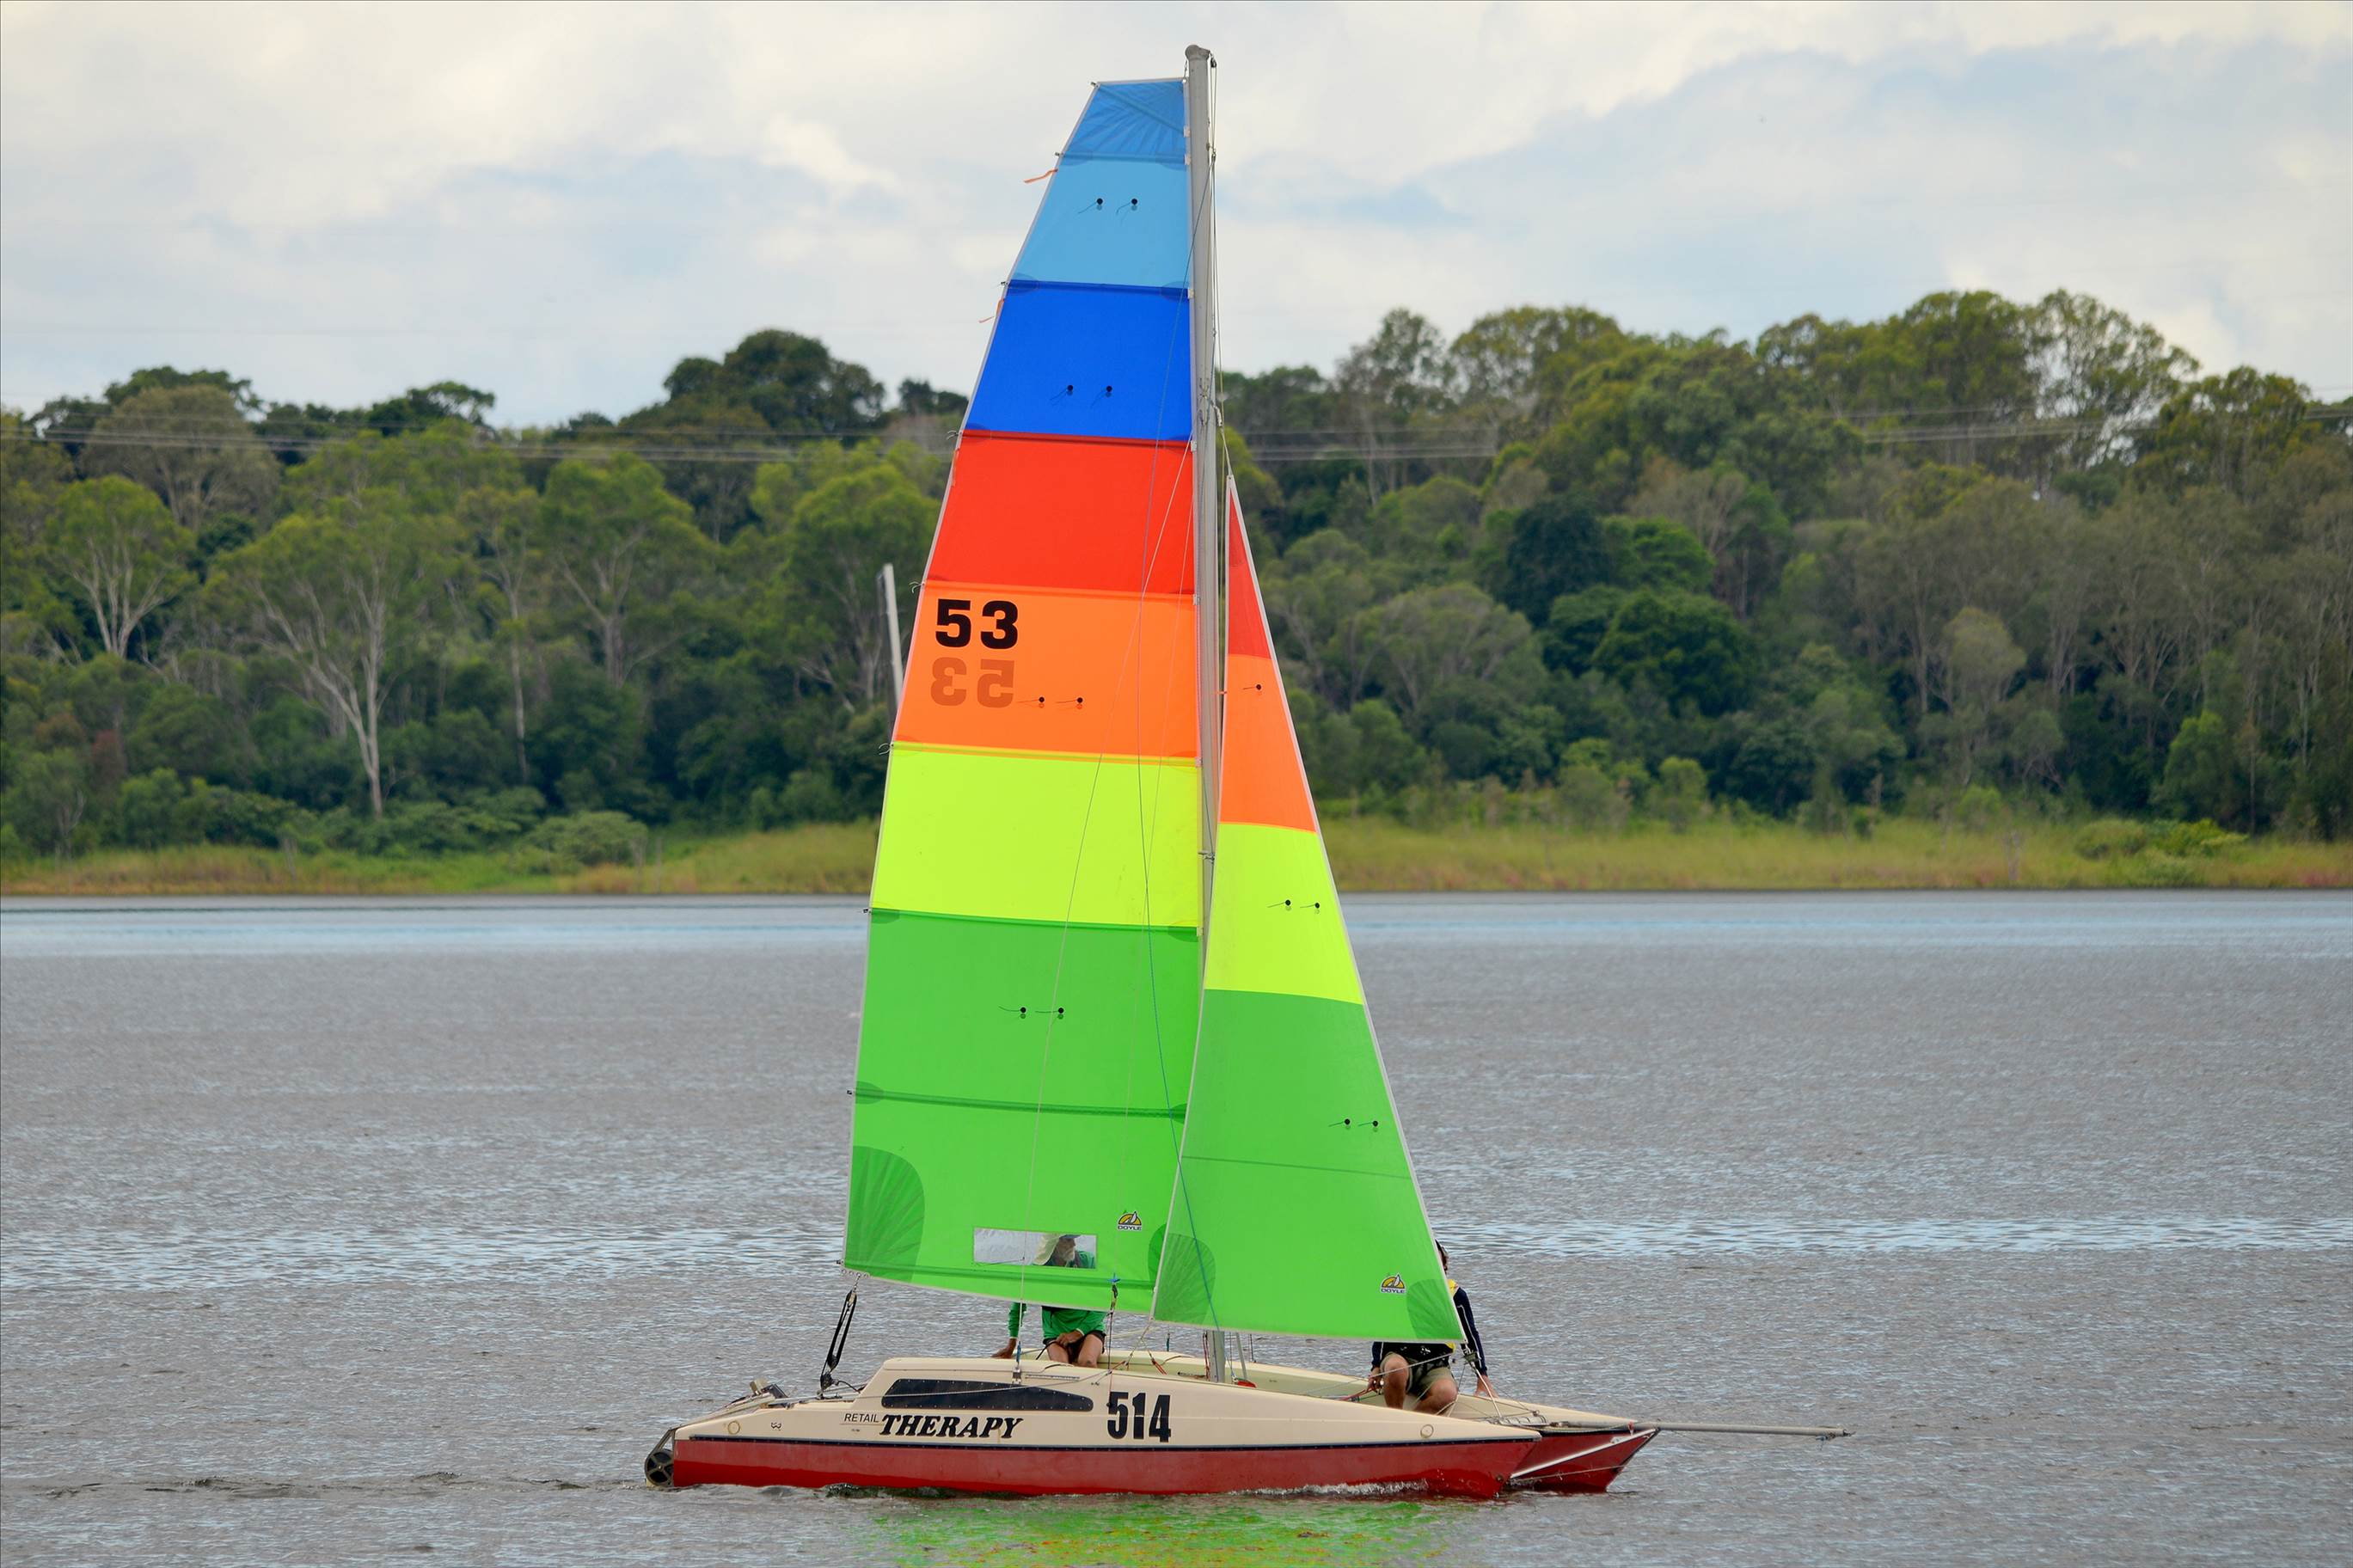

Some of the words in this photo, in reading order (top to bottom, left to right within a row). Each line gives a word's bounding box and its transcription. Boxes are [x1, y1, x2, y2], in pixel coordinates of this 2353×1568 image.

[935, 598, 1018, 650] 53
[844, 1412, 879, 1424] RETAIL
[879, 1414, 1024, 1439] THERAPY
[1107, 1391, 1172, 1443] 514
